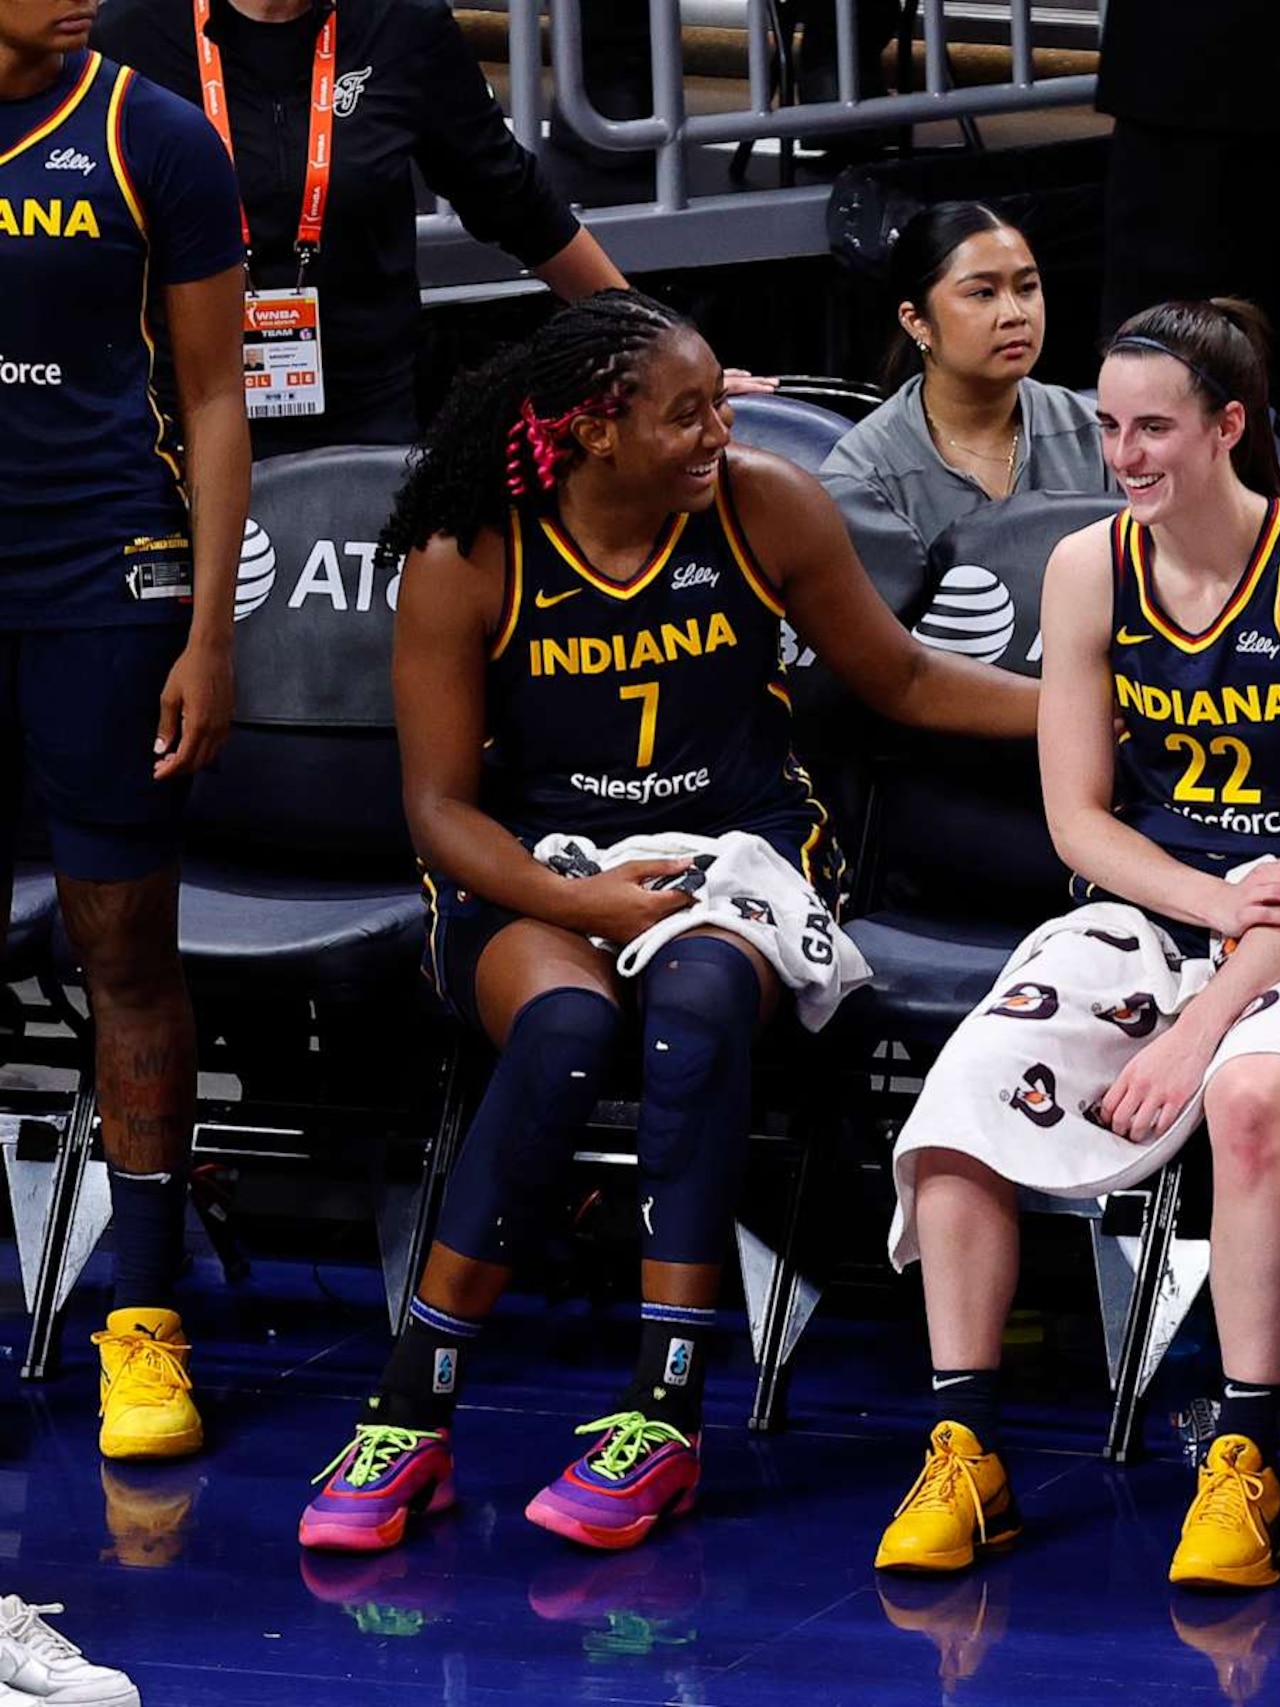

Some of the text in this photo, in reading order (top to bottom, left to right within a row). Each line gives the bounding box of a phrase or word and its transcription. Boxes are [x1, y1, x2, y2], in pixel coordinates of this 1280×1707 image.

[45, 147, 97, 176] Lilly
[256, 310, 300, 321] WNBA
[262, 328, 293, 337] TEAM
[0, 354, 62, 386] orce
[671, 563, 720, 590] Lilly
[530, 612, 738, 676] INDIANA
[1236, 630, 1280, 660] Lilly
[619, 682, 660, 768] 7
[1165, 733, 1261, 804] 22
